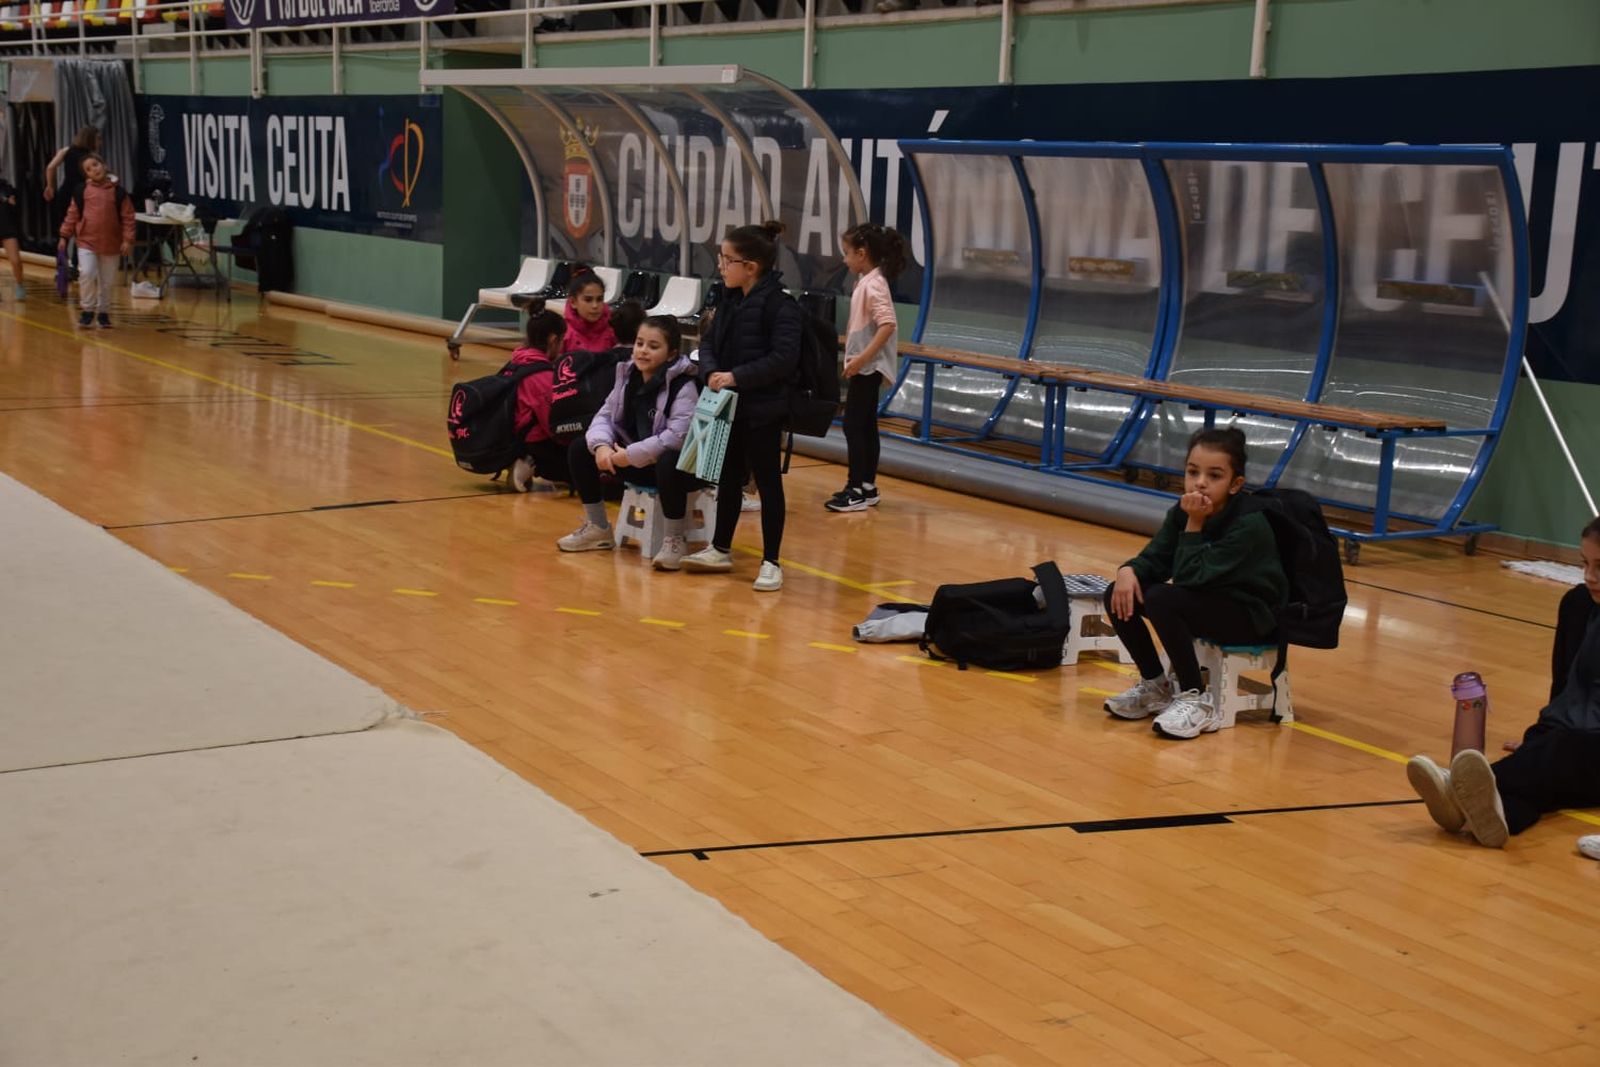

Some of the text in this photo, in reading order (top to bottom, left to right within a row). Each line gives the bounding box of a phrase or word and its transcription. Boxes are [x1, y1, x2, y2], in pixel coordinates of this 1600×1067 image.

[182, 113, 351, 212] VISITA CEUTA
[617, 132, 782, 247] CIUDAD
